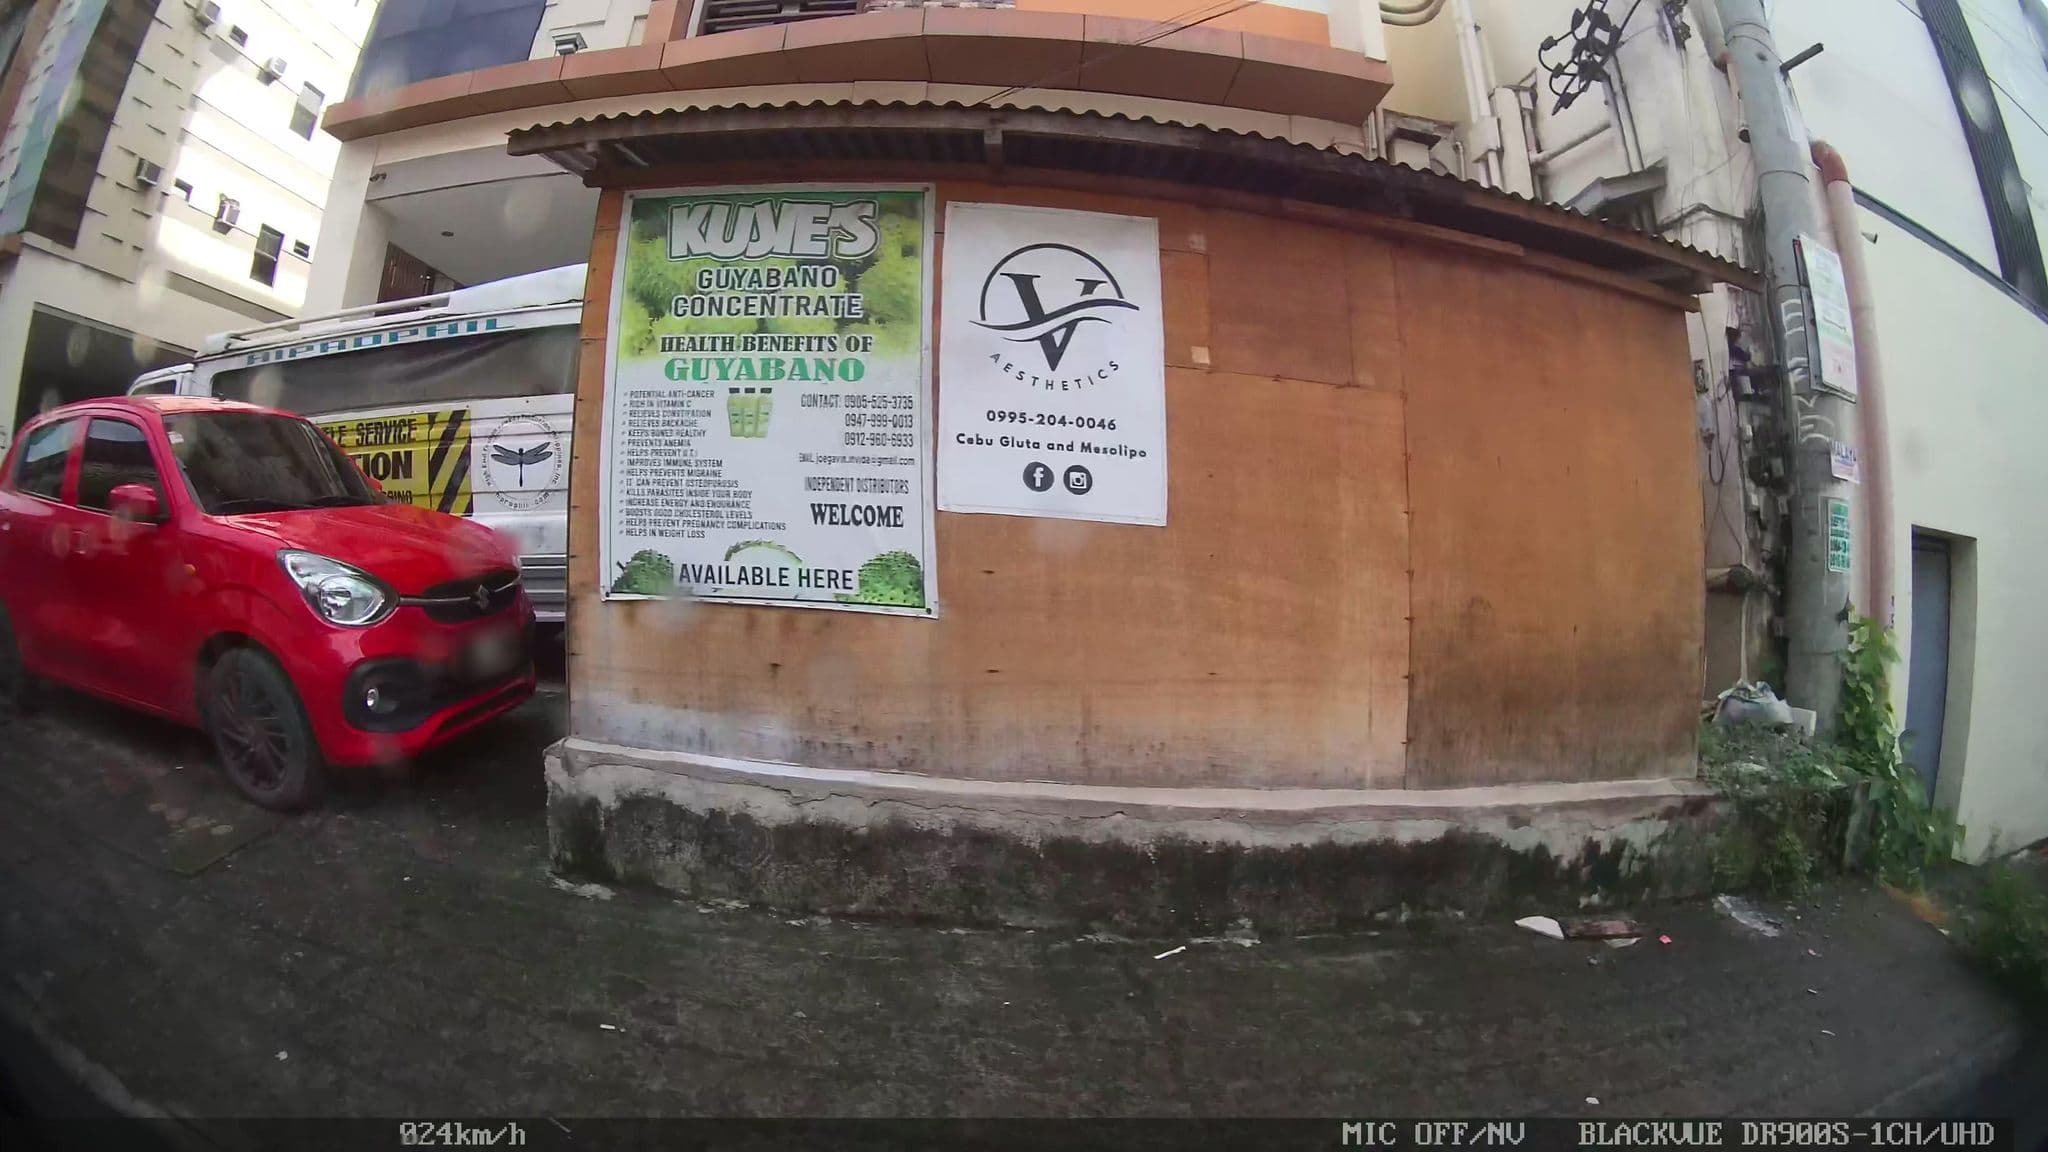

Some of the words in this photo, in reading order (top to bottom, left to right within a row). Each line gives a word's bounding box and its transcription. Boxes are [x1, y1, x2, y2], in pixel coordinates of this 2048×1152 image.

[698, 267, 838, 289] GUYABANO
[673, 295, 864, 318] CONCENTRATE
[660, 336, 739, 352] HEALTH
[743, 336, 838, 352] BENEFITS
[845, 336, 873, 352] OF
[664, 357, 865, 382] GUYABANO
[989, 352, 1120, 391] AESTHETICS
[630, 390, 665, 398] POTENTIAL
[669, 390, 714, 398] ANTI-CANCER
[986, 410, 1117, 431] 0995-204-0046
[356, 419, 417, 446] SERVICE
[628, 429, 649, 437] KEEPS
[664, 439, 691, 447] ANEMIA
[1000, 436, 1040, 450] Gluta
[1047, 440, 1074, 452] and
[663, 459, 692, 467] IMMUNE
[649, 469, 685, 477] PREVENTS
[652, 479, 683, 487] PREVENT
[649, 489, 683, 497] PARASITES
[686, 489, 711, 497] INSIDE
[712, 490, 731, 498] YOUR
[733, 490, 752, 498] BODY
[626, 499, 658, 507] INCREASE
[661, 499, 688, 508] ENERGY
[690, 500, 705, 508] AND
[707, 500, 750, 509] ENDURANCE
[675, 509, 724, 518] CHOLESTEROL
[726, 510, 752, 519] LEVELS
[810, 503, 904, 528] WELCOME
[626, 519, 647, 527] HELPS
[650, 519, 680, 528] PREVENT
[682, 520, 724, 529] PREGNANCY
[727, 521, 786, 531] COMPLICATIONS
[626, 528, 647, 536] HELPS
[650, 529, 655, 537] IN
[658, 529, 685, 538] WEIGHT
[687, 530, 705, 538] LOSS
[679, 564, 790, 587] AVAILABLE
[798, 567, 853, 590] HERE
